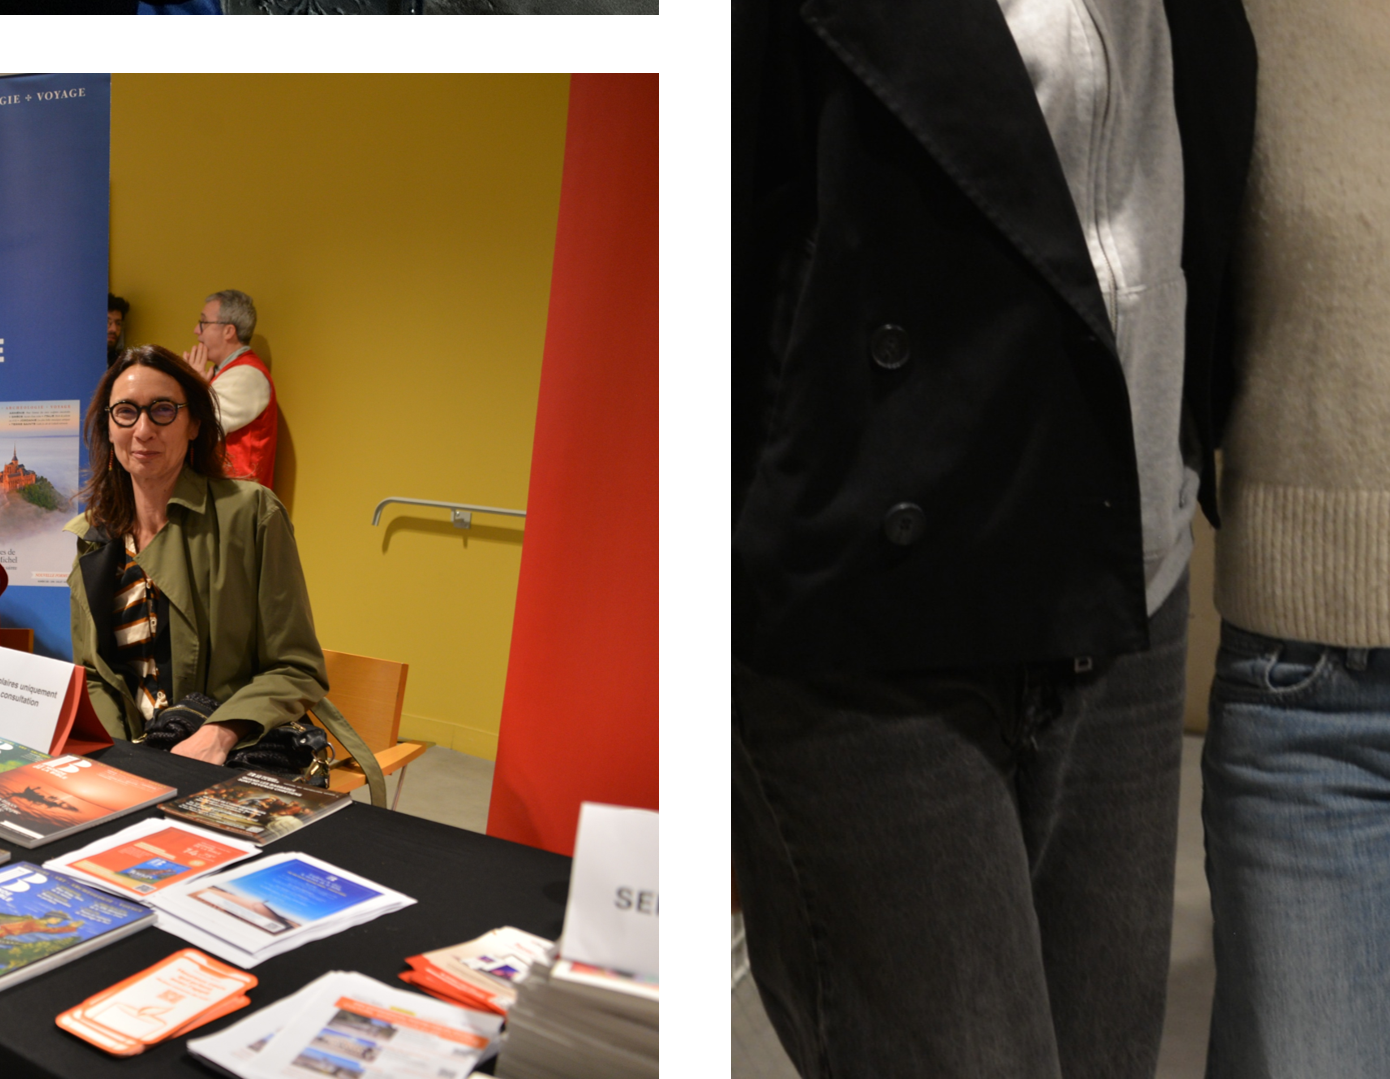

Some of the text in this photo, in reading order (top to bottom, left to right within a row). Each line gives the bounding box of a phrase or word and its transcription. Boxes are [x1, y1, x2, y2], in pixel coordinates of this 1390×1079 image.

[36, 88, 86, 101] VOYAGE
[0, 691, 39, 707] consultation
[20, 684, 58, 699] uniquement
